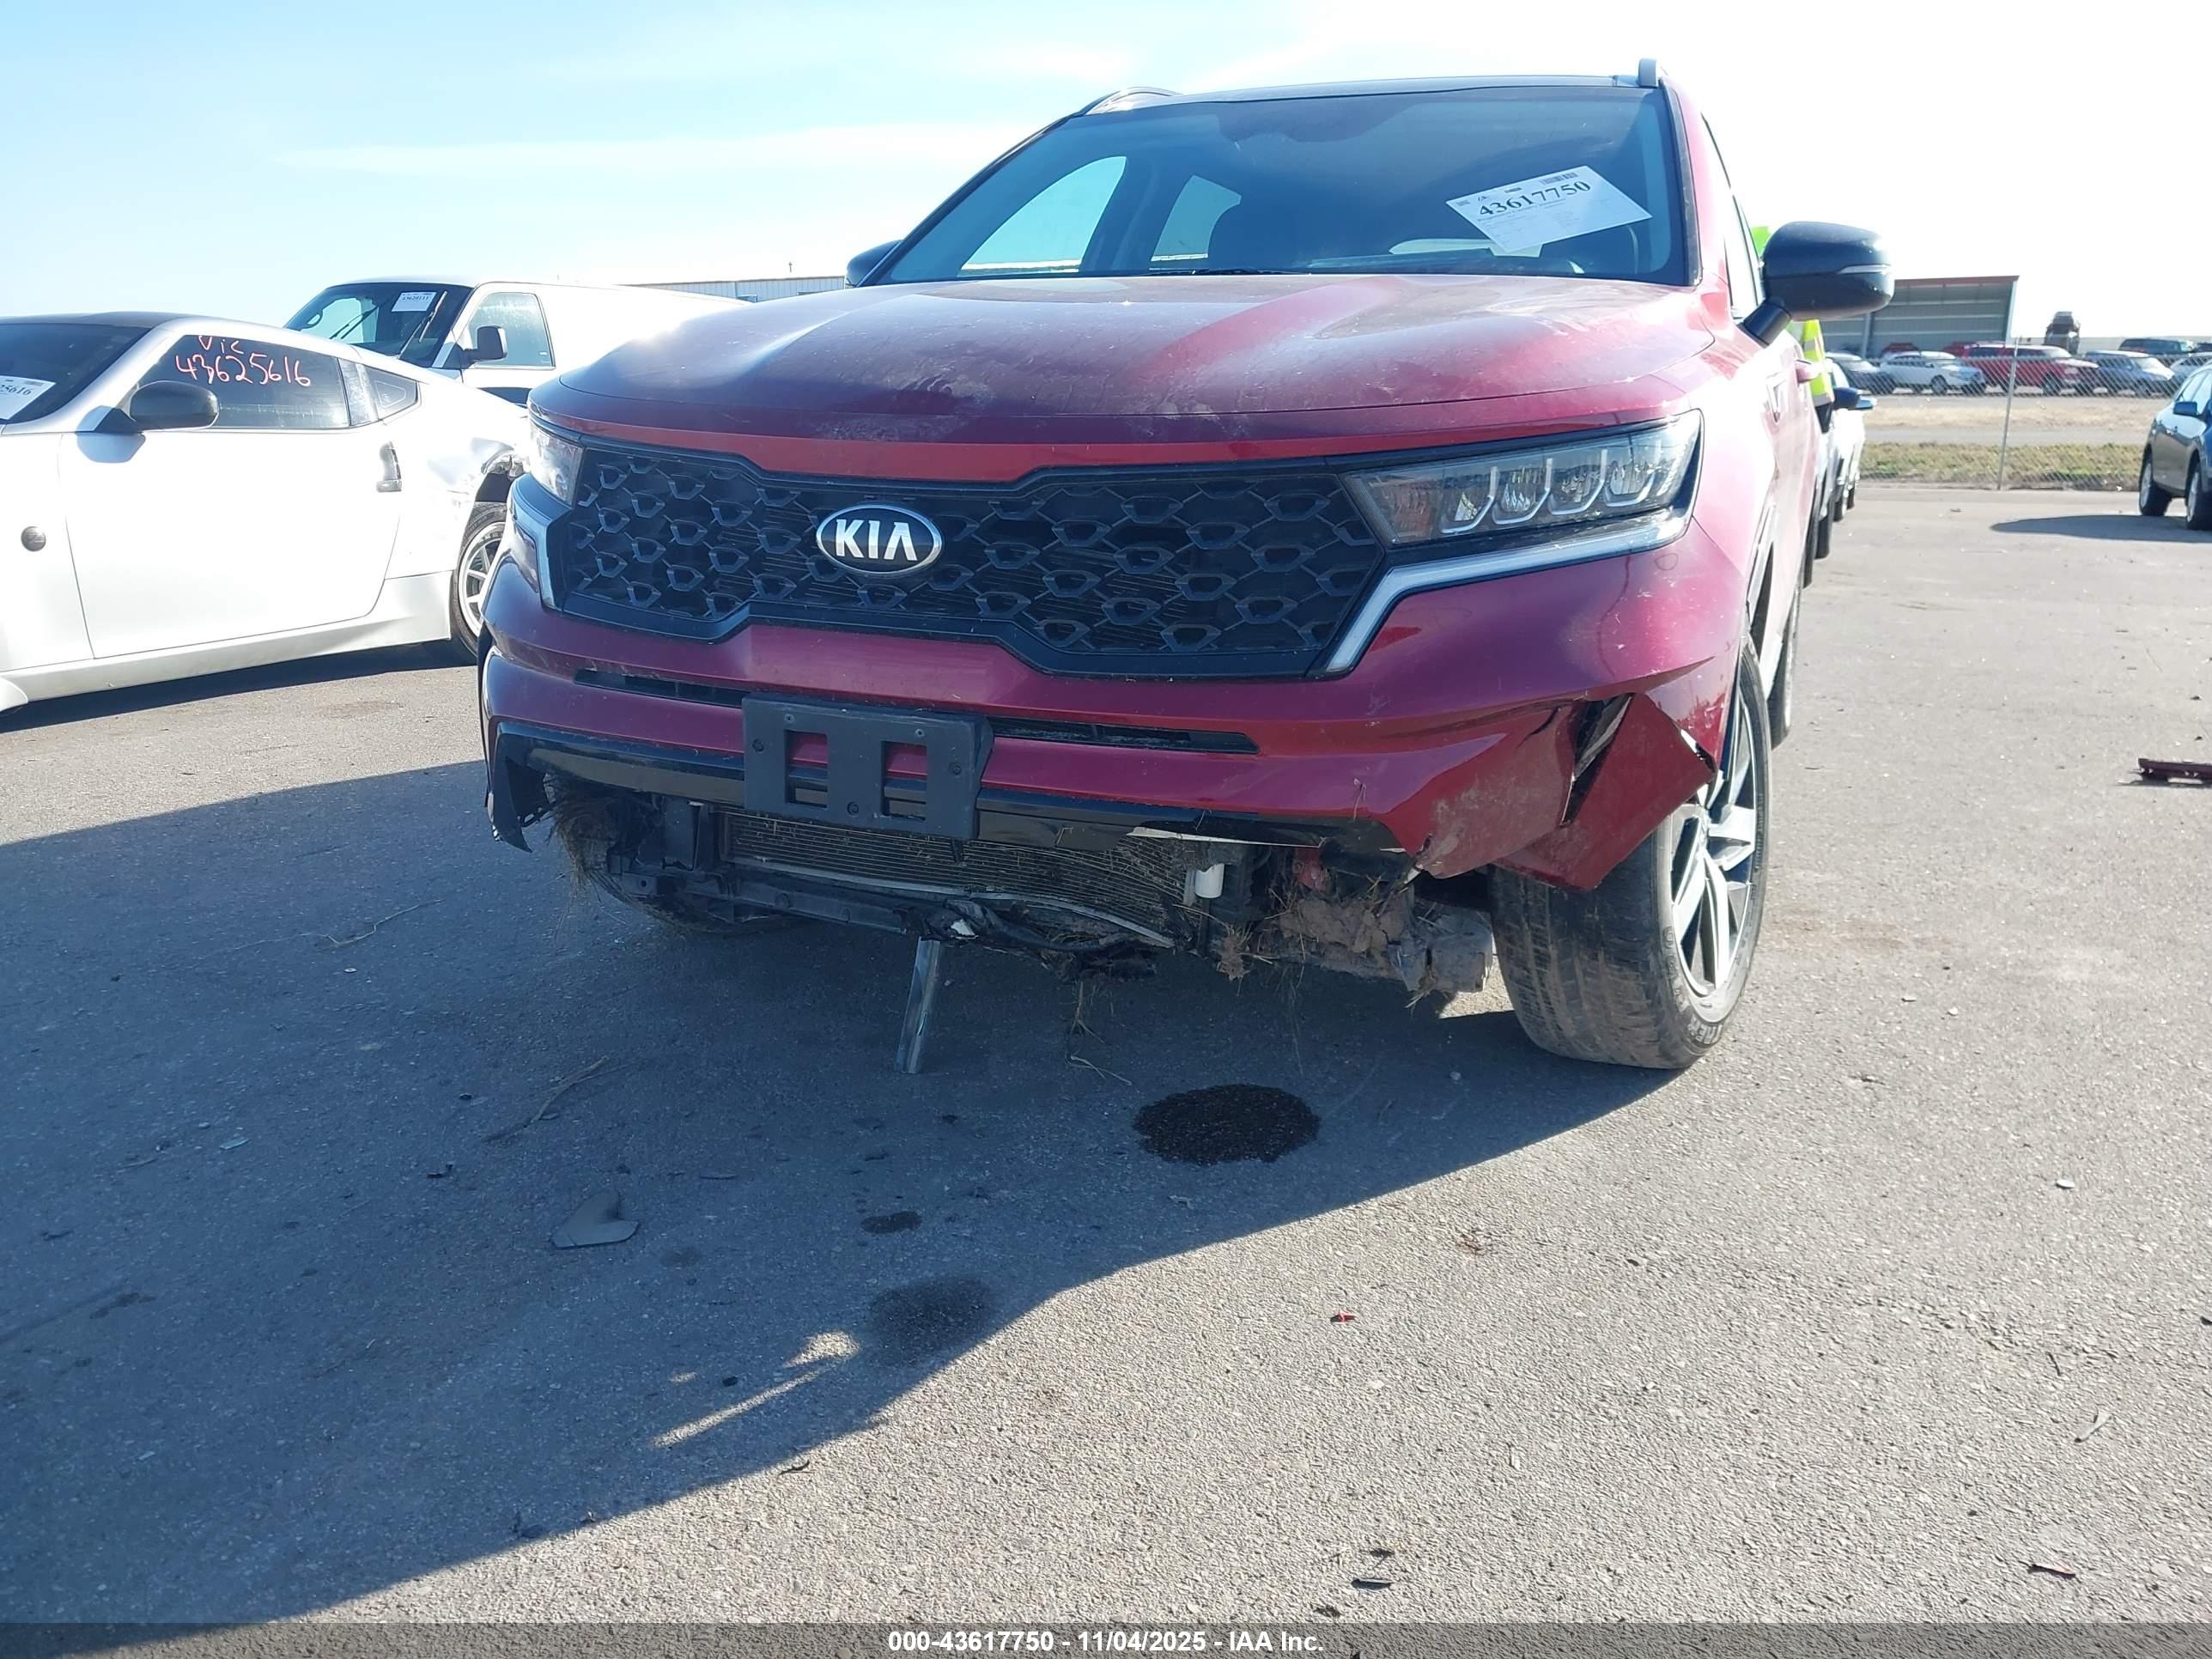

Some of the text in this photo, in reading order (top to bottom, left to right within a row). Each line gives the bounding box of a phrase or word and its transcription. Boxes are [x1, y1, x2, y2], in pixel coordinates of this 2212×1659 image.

[1479, 179, 1592, 216] 43617750
[175, 352, 312, 387] 43625616
[835, 519, 919, 562] KIA
